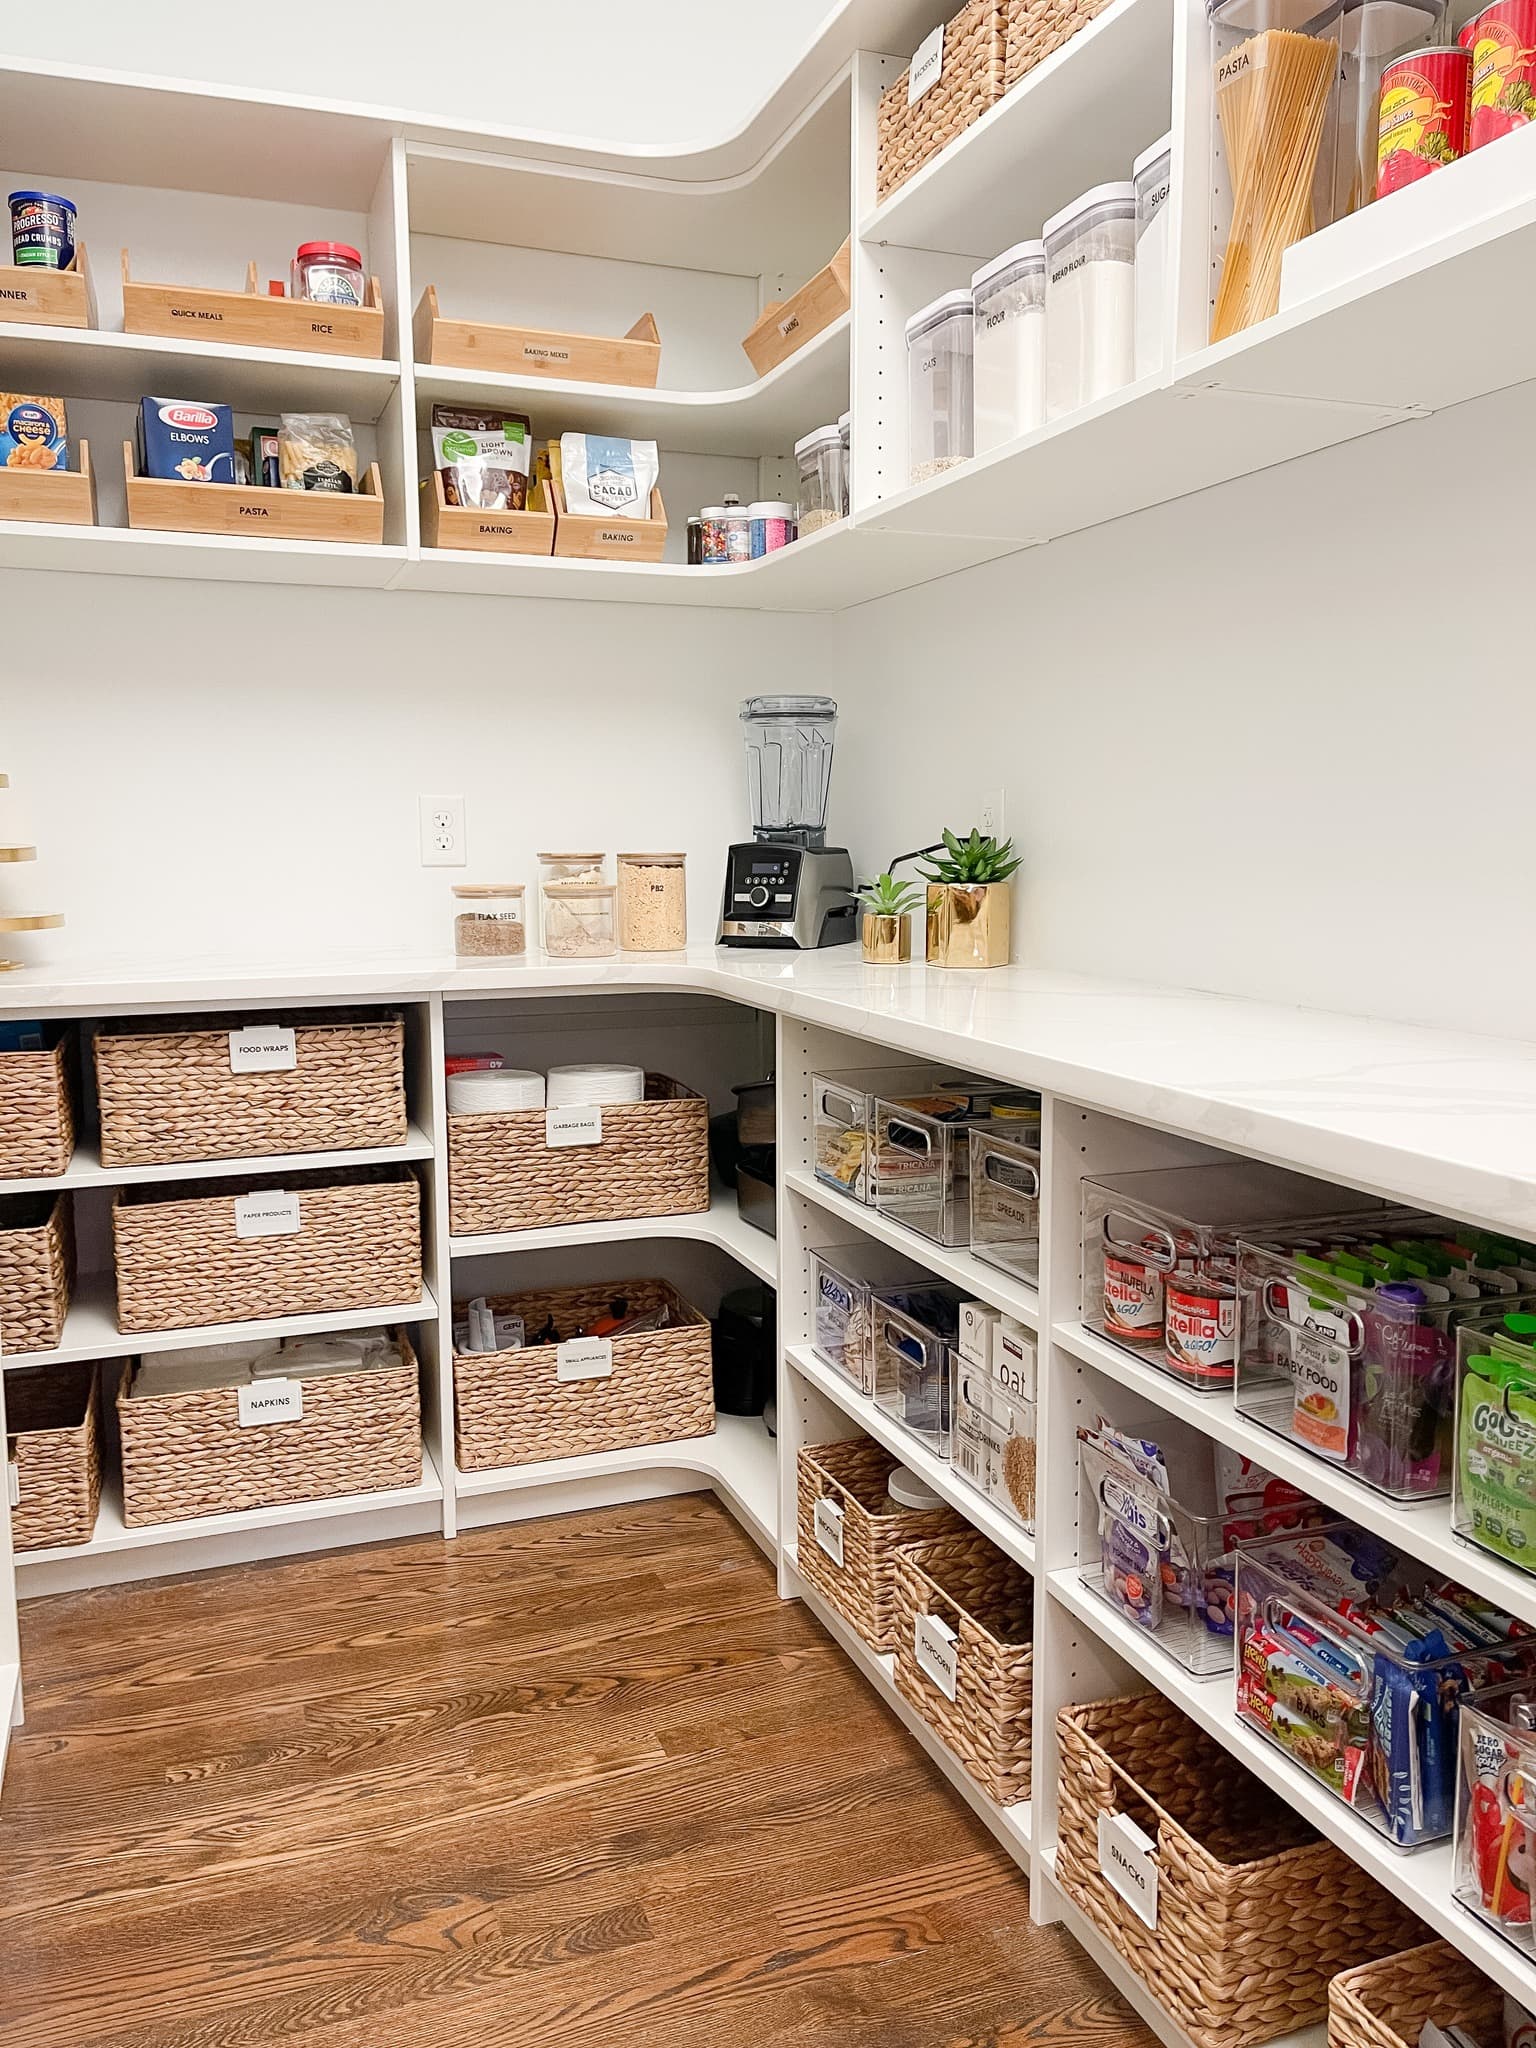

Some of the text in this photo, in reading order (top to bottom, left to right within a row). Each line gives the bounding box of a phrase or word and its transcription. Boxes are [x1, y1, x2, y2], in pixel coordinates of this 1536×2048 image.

[1219, 53, 1250, 82] PASTA
[1151, 183, 1170, 207] SUGA
[31, 233, 62, 247] CRUMBS
[1052, 255, 1086, 284] BREAD FLOUR
[0, 289, 28, 301] NNER
[171, 309, 223, 321] QUICK MEALS
[987, 310, 1006, 329] FLOUR
[311, 323, 333, 335] RICE
[172, 410, 213, 425] Barilla
[170, 432, 210, 445] ELBOWS
[482, 449, 513, 457] BROWN
[593, 484, 632, 497] CACAO
[239, 506, 269, 517] PASTA
[479, 525, 513, 535] BAKING
[602, 533, 634, 542] BAKING
[478, 912, 516, 921] FLAX SEED
[239, 1044, 289, 1054] FOOD WRAPS
[553, 1122, 579, 1130] GARBAGE
[997, 1201, 1025, 1224] SPREADS
[1105, 1281, 1141, 1303] tella
[1120, 1271, 1155, 1300] NUTELLA
[1168, 1313, 1215, 1339] utella
[1277, 1352, 1304, 1377] BABY
[1306, 1367, 1338, 1393] FOOD
[250, 1397, 290, 1409] NAPKINS
[920, 1636, 952, 1676] POPCORN
[1296, 1696, 1326, 1729] BARS
[1110, 1845, 1146, 1890] SNACKS
